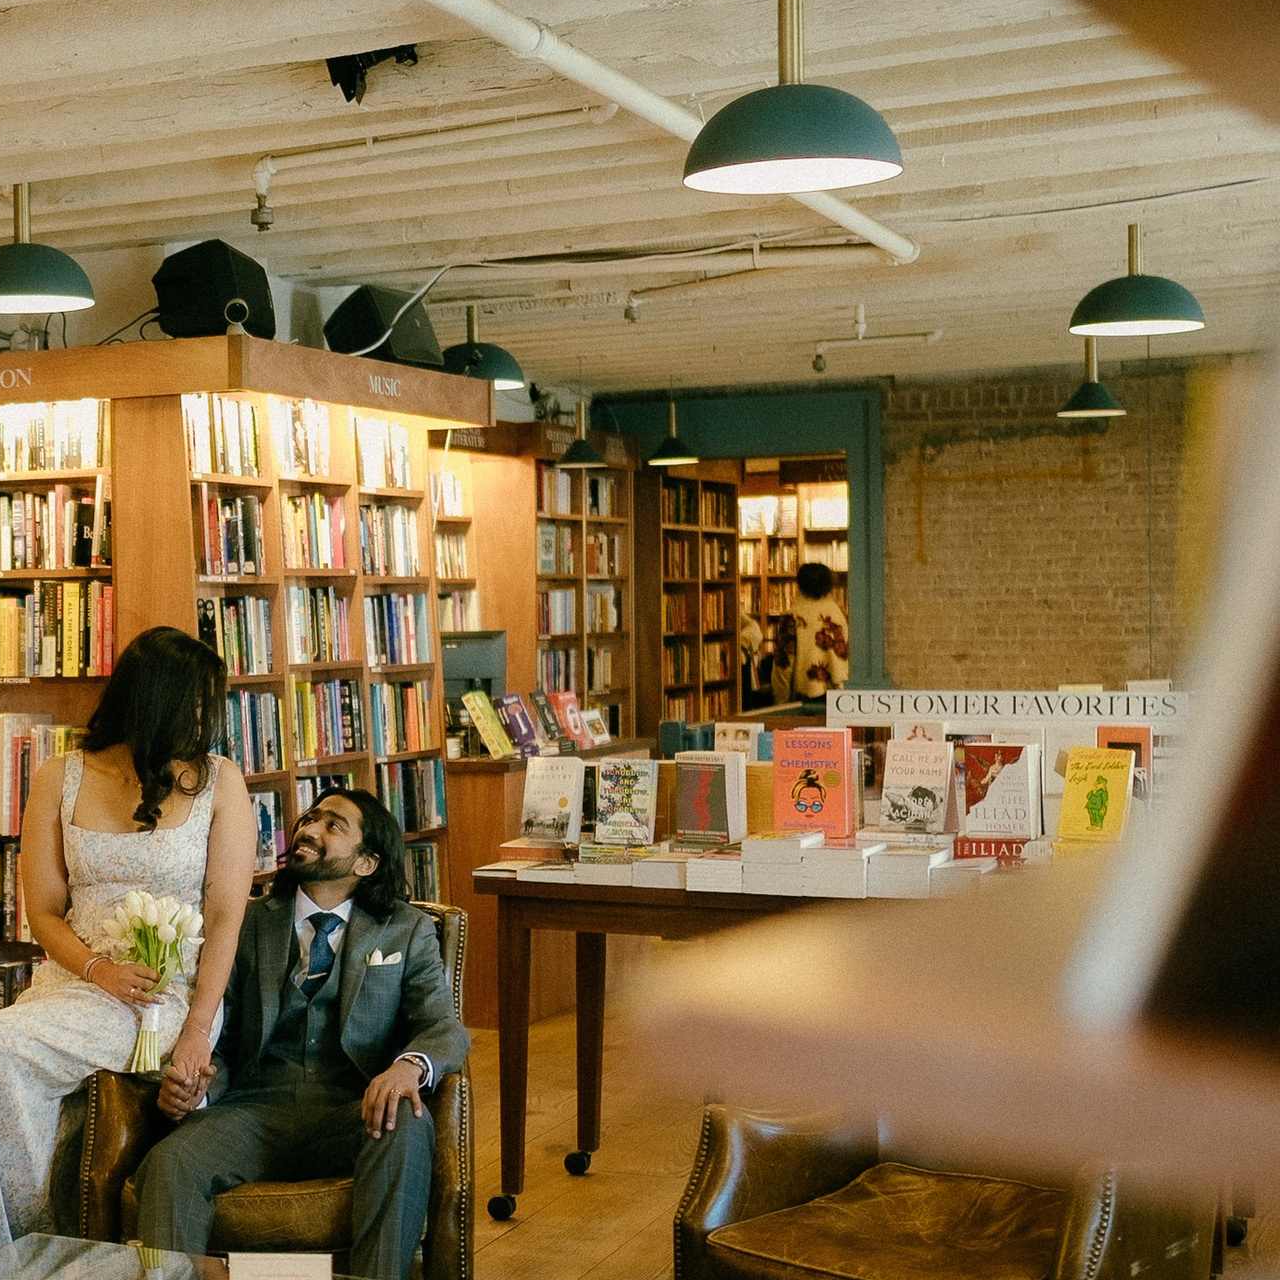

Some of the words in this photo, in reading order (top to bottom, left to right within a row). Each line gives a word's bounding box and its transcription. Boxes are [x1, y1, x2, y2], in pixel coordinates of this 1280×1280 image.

[369, 375, 402, 397] MUSIC
[835, 694, 1000, 716] CUSTOMER
[1012, 695, 1178, 717] FAVORITES
[785, 740, 832, 749] LESSONS
[892, 753, 915, 762] CALL
[918, 754, 930, 763] ME
[933, 755, 944, 763] BY
[780, 759, 838, 769] CHEMISTRY
[1070, 762, 1084, 771] The
[1085, 762, 1101, 771] Good
[1102, 762, 1128, 771] Soldier
[890, 767, 916, 776] YOUR
[919, 768, 943, 777] NAME
[1000, 796, 1024, 805] THE
[974, 808, 1027, 820] ILIAD
[985, 823, 1026, 831] HOMER
[972, 841, 1023, 856] ILIAD
